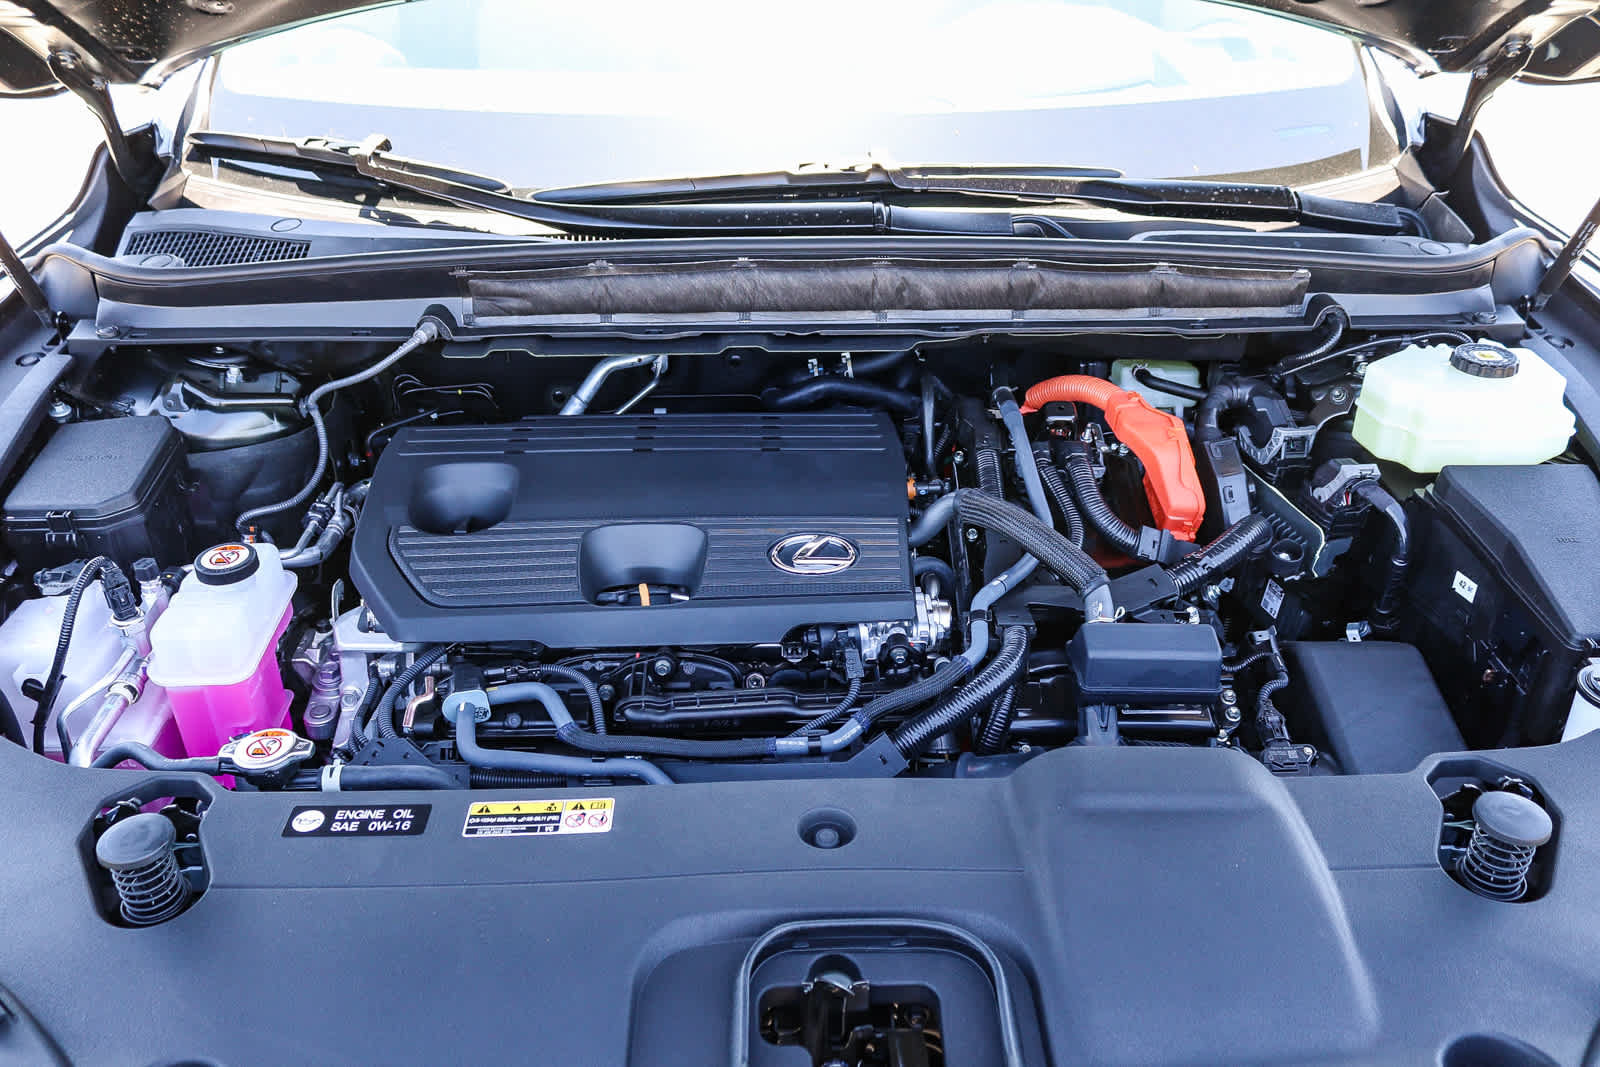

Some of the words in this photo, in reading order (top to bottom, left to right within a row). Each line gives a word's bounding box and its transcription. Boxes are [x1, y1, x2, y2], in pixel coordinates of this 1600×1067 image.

[334, 809, 386, 820] ENGINE
[392, 808, 415, 819] OIL
[330, 821, 360, 832] SAE
[367, 820, 411, 831] 0W-16
